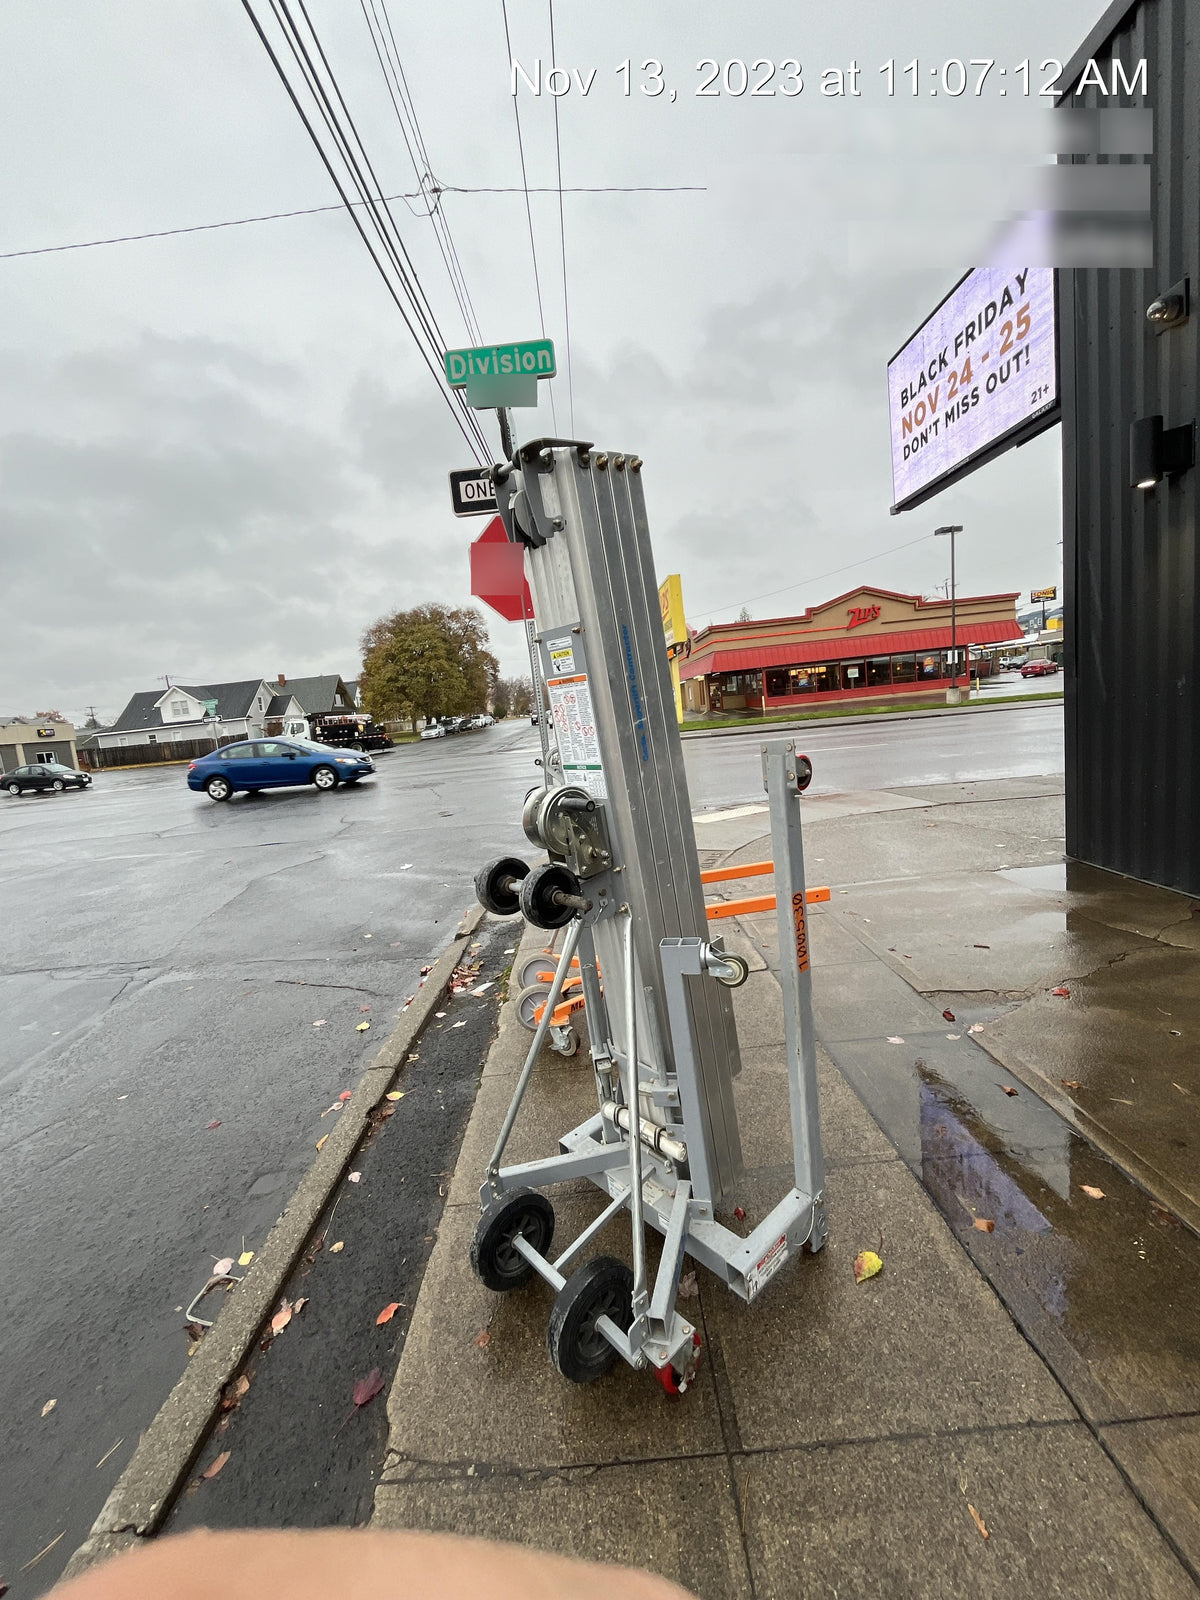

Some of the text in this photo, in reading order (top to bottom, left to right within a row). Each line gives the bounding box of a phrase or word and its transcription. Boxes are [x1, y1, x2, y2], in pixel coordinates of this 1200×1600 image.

[449, 347, 552, 380] Division
[901, 267, 1029, 409] BLACK FRIDAY
[901, 385, 940, 440] NOV
[947, 357, 974, 401] 24
[999, 301, 1031, 356] 25
[903, 344, 1030, 461] DON'T MISS OUT!
[1030, 384, 1050, 405] 21+
[464, 480, 496, 499] ONE
